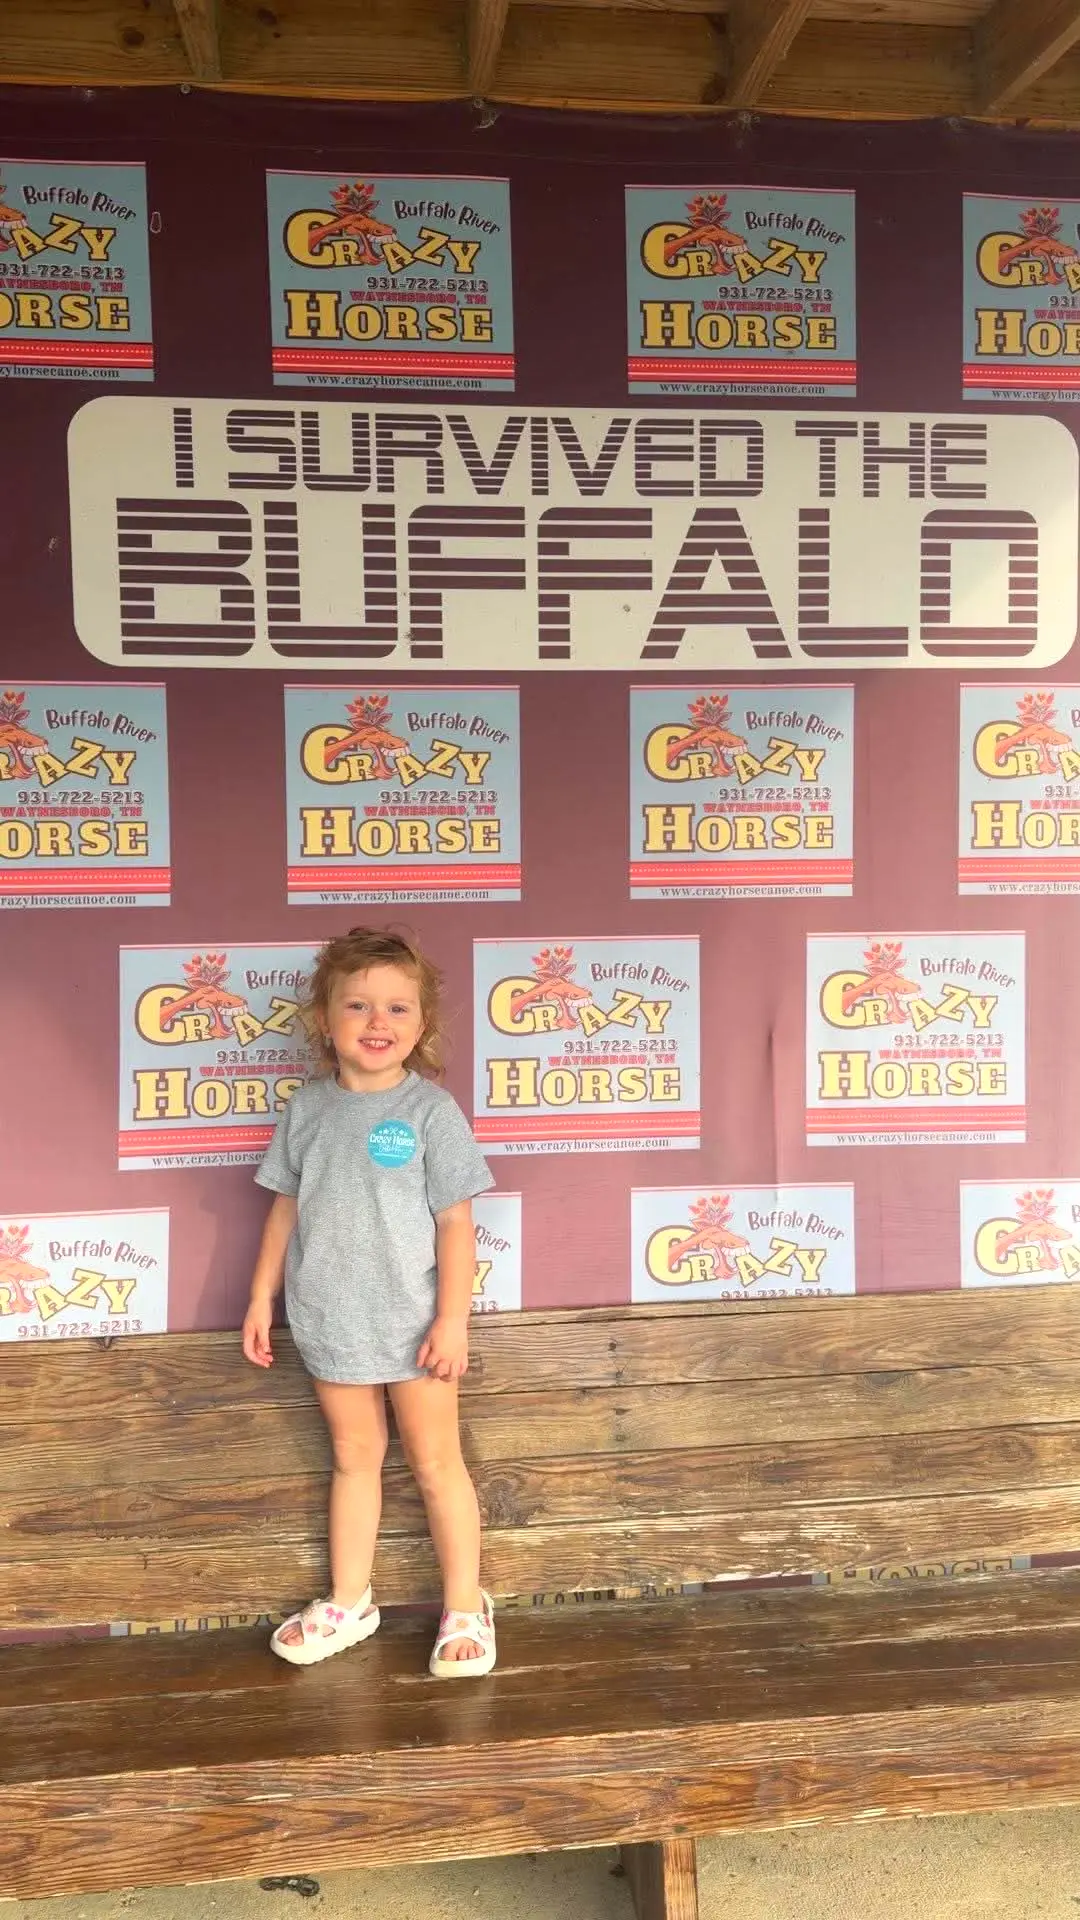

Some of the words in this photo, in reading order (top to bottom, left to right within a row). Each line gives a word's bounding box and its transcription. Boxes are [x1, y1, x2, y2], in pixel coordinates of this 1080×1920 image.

[23, 185, 89, 205] Buffalo
[92, 191, 136, 222] River
[394, 200, 455, 219] Buffalo
[458, 205, 500, 234] River
[283, 209, 481, 274] CRAZY
[745, 211, 803, 230] Buffalo
[805, 217, 845, 245] River
[640, 221, 827, 284] CRAZY
[367, 277, 488, 293] 931-722-5213
[719, 286, 833, 300] 931-722-5213
[284, 289, 493, 342] HORSE
[640, 300, 836, 350] HORSE
[307, 375, 482, 389] www.crazyhorsecanoe.com
[659, 383, 825, 396] www.crazyhorsecanoe.com
[173, 407, 194, 488] I
[226, 409, 763, 497] SURVIVED
[795, 420, 987, 499] THE
[116, 498, 1038, 659] BUFFALO
[45, 709, 109, 730] Buffalo
[112, 714, 156, 744] River
[407, 712, 467, 731] Buffalo
[469, 716, 510, 744] River
[746, 711, 803, 730] Buffalo
[805, 714, 844, 742] River
[300, 723, 491, 788] CRAZY
[644, 723, 825, 785] CRAZY
[18, 791, 144, 804] 931-722-5213
[380, 790, 498, 804] 931-722-5213
[719, 787, 831, 800] 931-722-5213
[1, 807, 114, 818] WAYNESBORO,
[120, 807, 142, 816] TN
[643, 804, 834, 853] HORSE
[300, 807, 500, 857] HORSE
[320, 890, 489, 903] www.crazyhorsecanoe.com
[661, 886, 822, 899] www.crazyhorsecanoe.com
[591, 963, 648, 981] Buffalo
[650, 965, 690, 993] River
[920, 957, 976, 976] Buffalo
[978, 960, 1015, 988] River
[135, 984, 300, 1048] CRAZ
[487, 976, 671, 1038] CRAZY
[819, 970, 998, 1032] CRAZY
[564, 1039, 678, 1054] 931-722-5213
[894, 1034, 1004, 1046] 931-722-5213
[486, 1057, 680, 1108] HORSE
[818, 1050, 1006, 1099] HORSE
[133, 1067, 309, 1121] HORS
[504, 1139, 670, 1153] www.crazyhorsecanoe.com
[836, 1131, 996, 1144] www.crazyhorsecanoe.com
[748, 1210, 803, 1231] Buffalo
[806, 1213, 845, 1240] River
[49, 1240, 111, 1261] Buffalo
[114, 1241, 157, 1269] River
[645, 1225, 827, 1288] CRAZY
[18, 1319, 142, 1337] 931-722-5213
